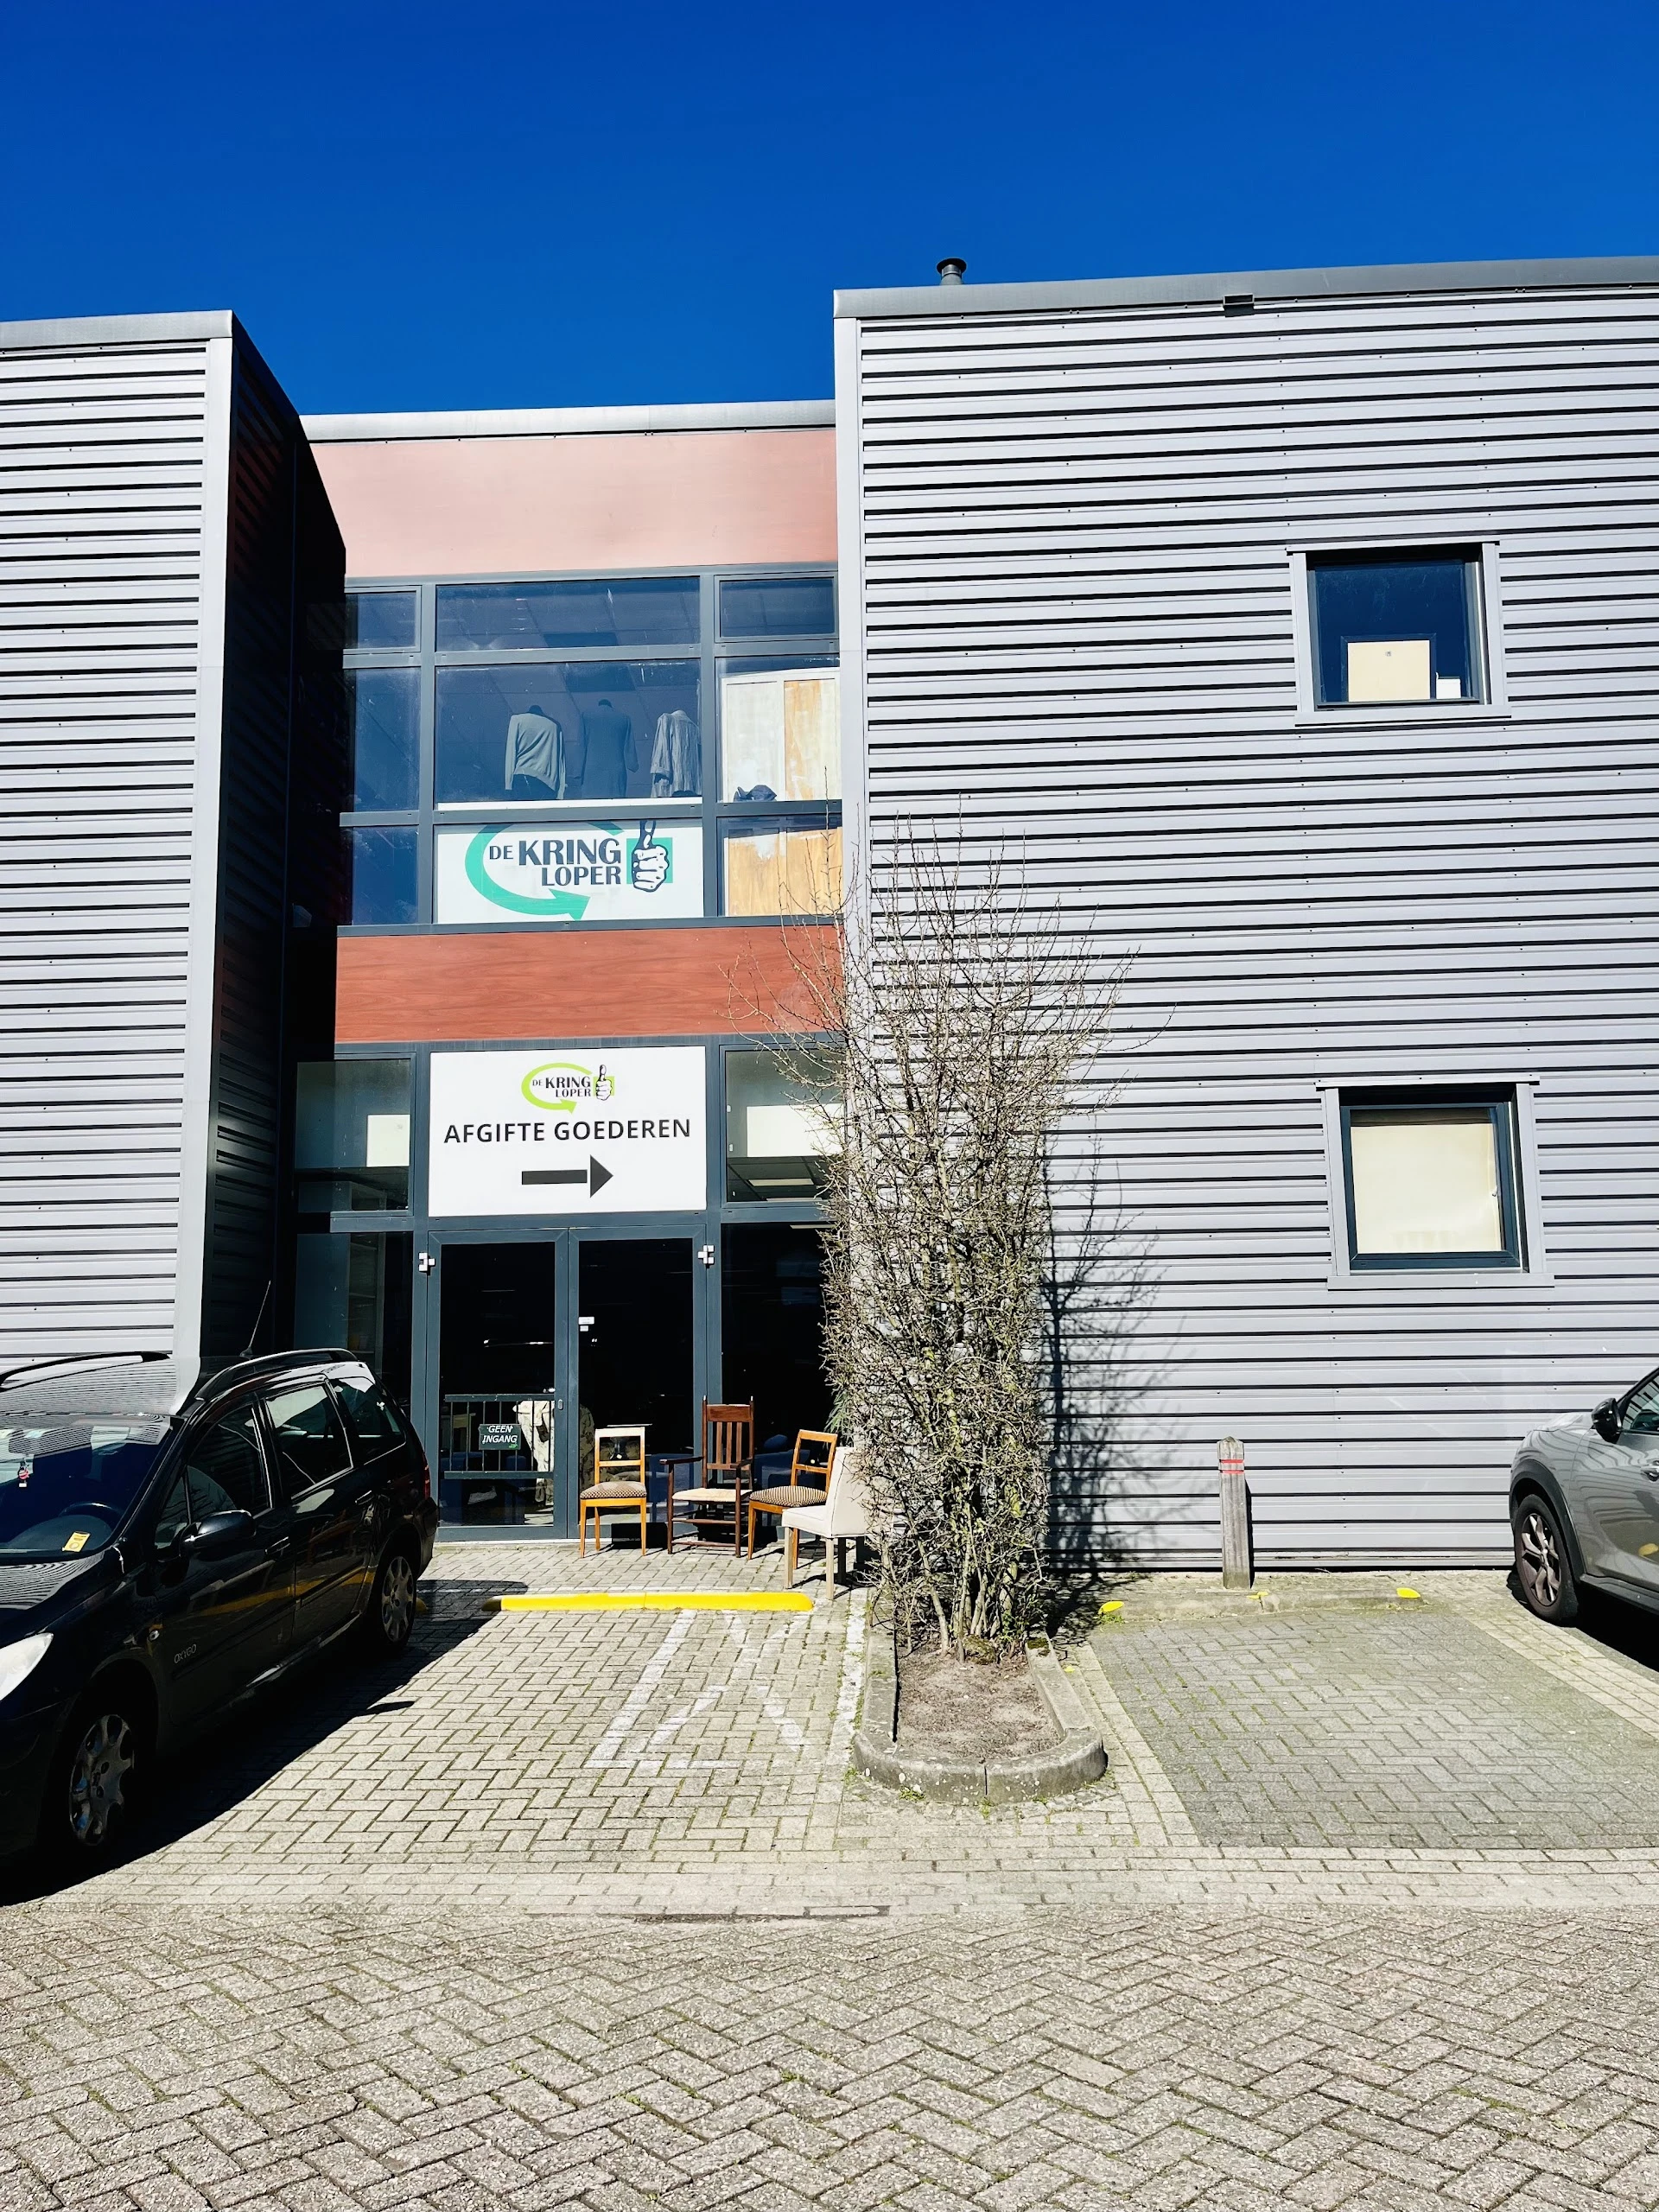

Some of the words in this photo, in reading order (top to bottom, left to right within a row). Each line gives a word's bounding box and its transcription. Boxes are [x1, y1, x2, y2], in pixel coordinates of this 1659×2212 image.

[489, 845, 514, 860] DE
[518, 837, 621, 866] KRING
[542, 866, 621, 887] LOPER
[545, 1076, 591, 1089] KRING
[555, 1088, 592, 1098] LOPER
[444, 1122, 545, 1143] AFGIFTE
[554, 1119, 691, 1141] GOEDEREN
[488, 1425, 513, 1433] GEEN
[482, 1434, 518, 1444] INGANG
